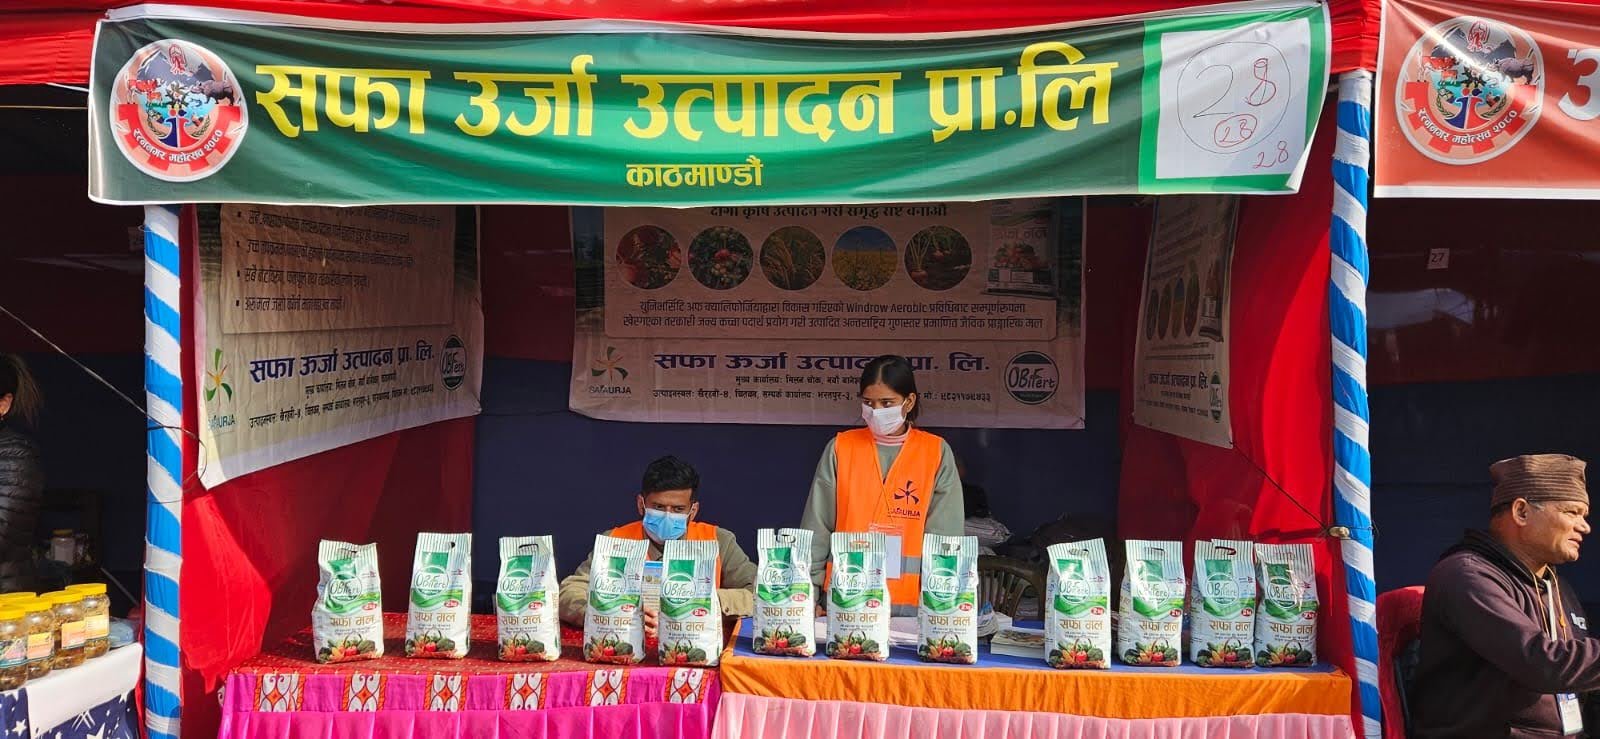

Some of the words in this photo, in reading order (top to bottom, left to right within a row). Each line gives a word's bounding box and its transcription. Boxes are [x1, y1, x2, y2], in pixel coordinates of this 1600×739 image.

[256, 64, 431, 138] सफा
[454, 54, 598, 137] उर्जा
[622, 72, 902, 142] उत्पादन
[1451, 130, 1492, 146] महोत्सव
[1492, 109, 1519, 134] २०८०
[1256, 139, 1290, 169] 28
[846, 301, 889, 313] Windrow
[890, 302, 928, 313] Aerobic
[664, 314, 696, 327] तरकारी
[250, 358, 296, 383] सफा
[343, 347, 394, 371] उत्पादन
[654, 353, 717, 369] सफा
[796, 353, 868, 370] उत्पाद
[835, 612, 856, 623] सफा
[859, 612, 878, 623] मल
[927, 615, 949, 626] सफा
[952, 615, 971, 626] मल
[1059, 619, 1081, 630] सफा
[1084, 620, 1104, 630] मल
[1139, 620, 1160, 631] सफा
[1209, 621, 1232, 631] सफा
[1269, 622, 1293, 634] सफा
